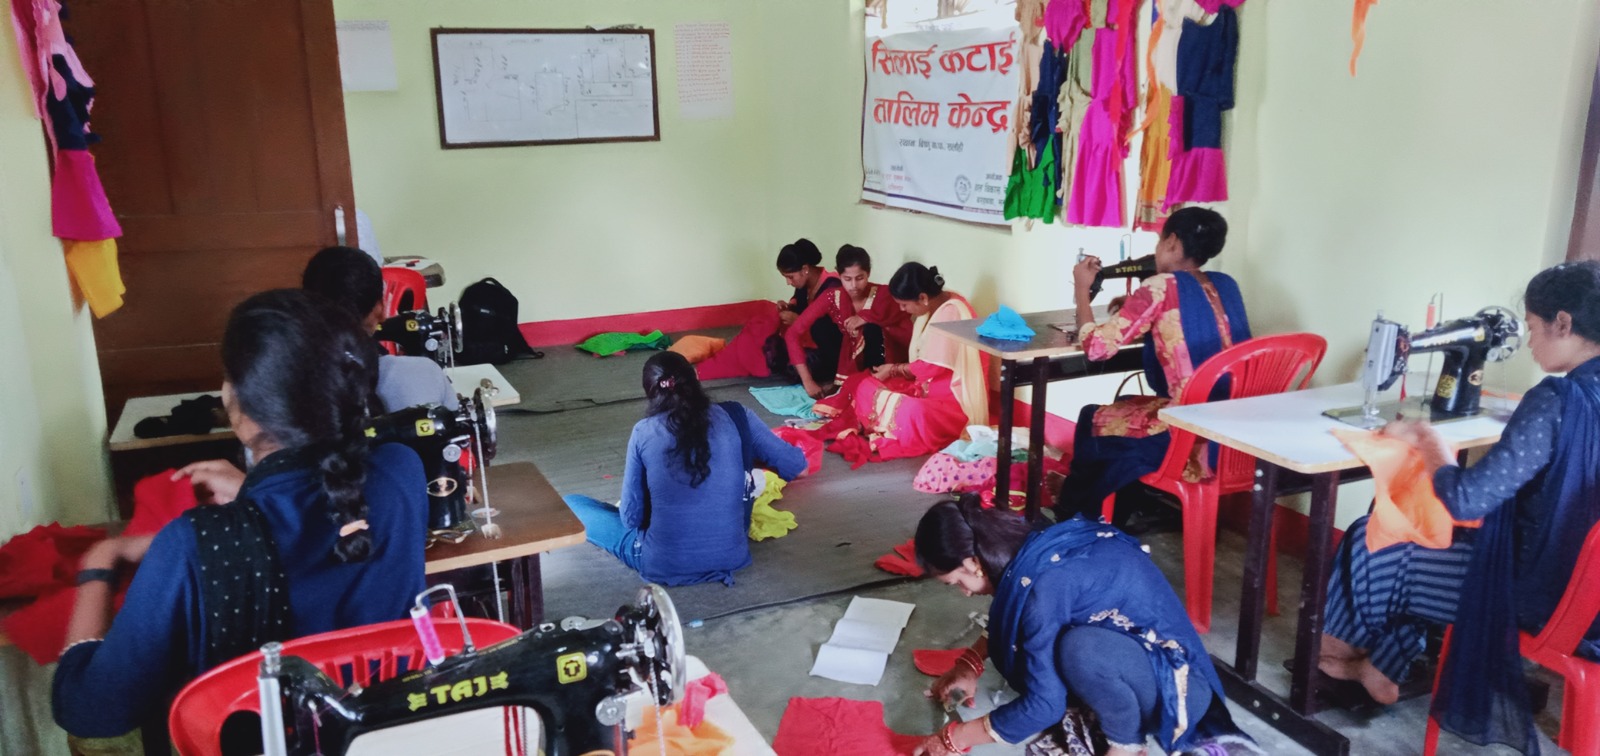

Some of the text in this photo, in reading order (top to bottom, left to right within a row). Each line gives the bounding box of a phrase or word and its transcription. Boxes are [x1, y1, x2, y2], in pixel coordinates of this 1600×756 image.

[871, 31, 1016, 79] सिलाई कटाई
[873, 91, 1011, 133] तालिम केन्द्र
[430, 676, 488, 705] TAJ
